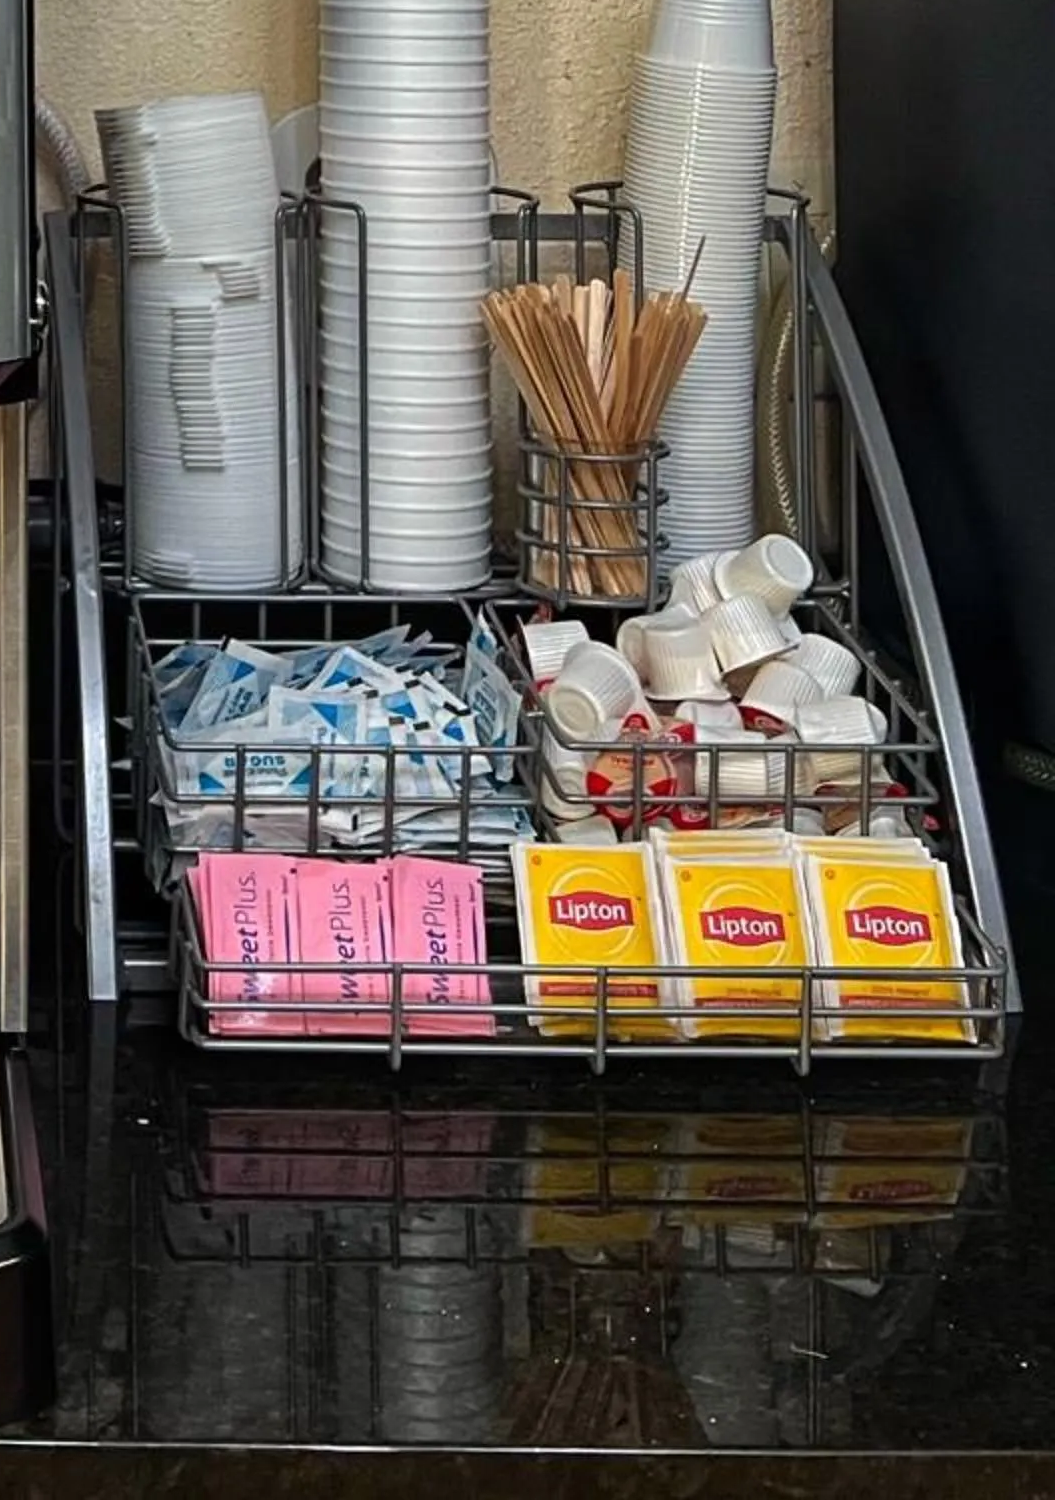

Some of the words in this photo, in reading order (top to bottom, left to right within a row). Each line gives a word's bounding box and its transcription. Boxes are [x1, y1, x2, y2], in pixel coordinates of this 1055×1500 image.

[556, 899, 627, 925] Lipton
[852, 912, 925, 938] Lipton
[707, 915, 778, 940] Lipton
